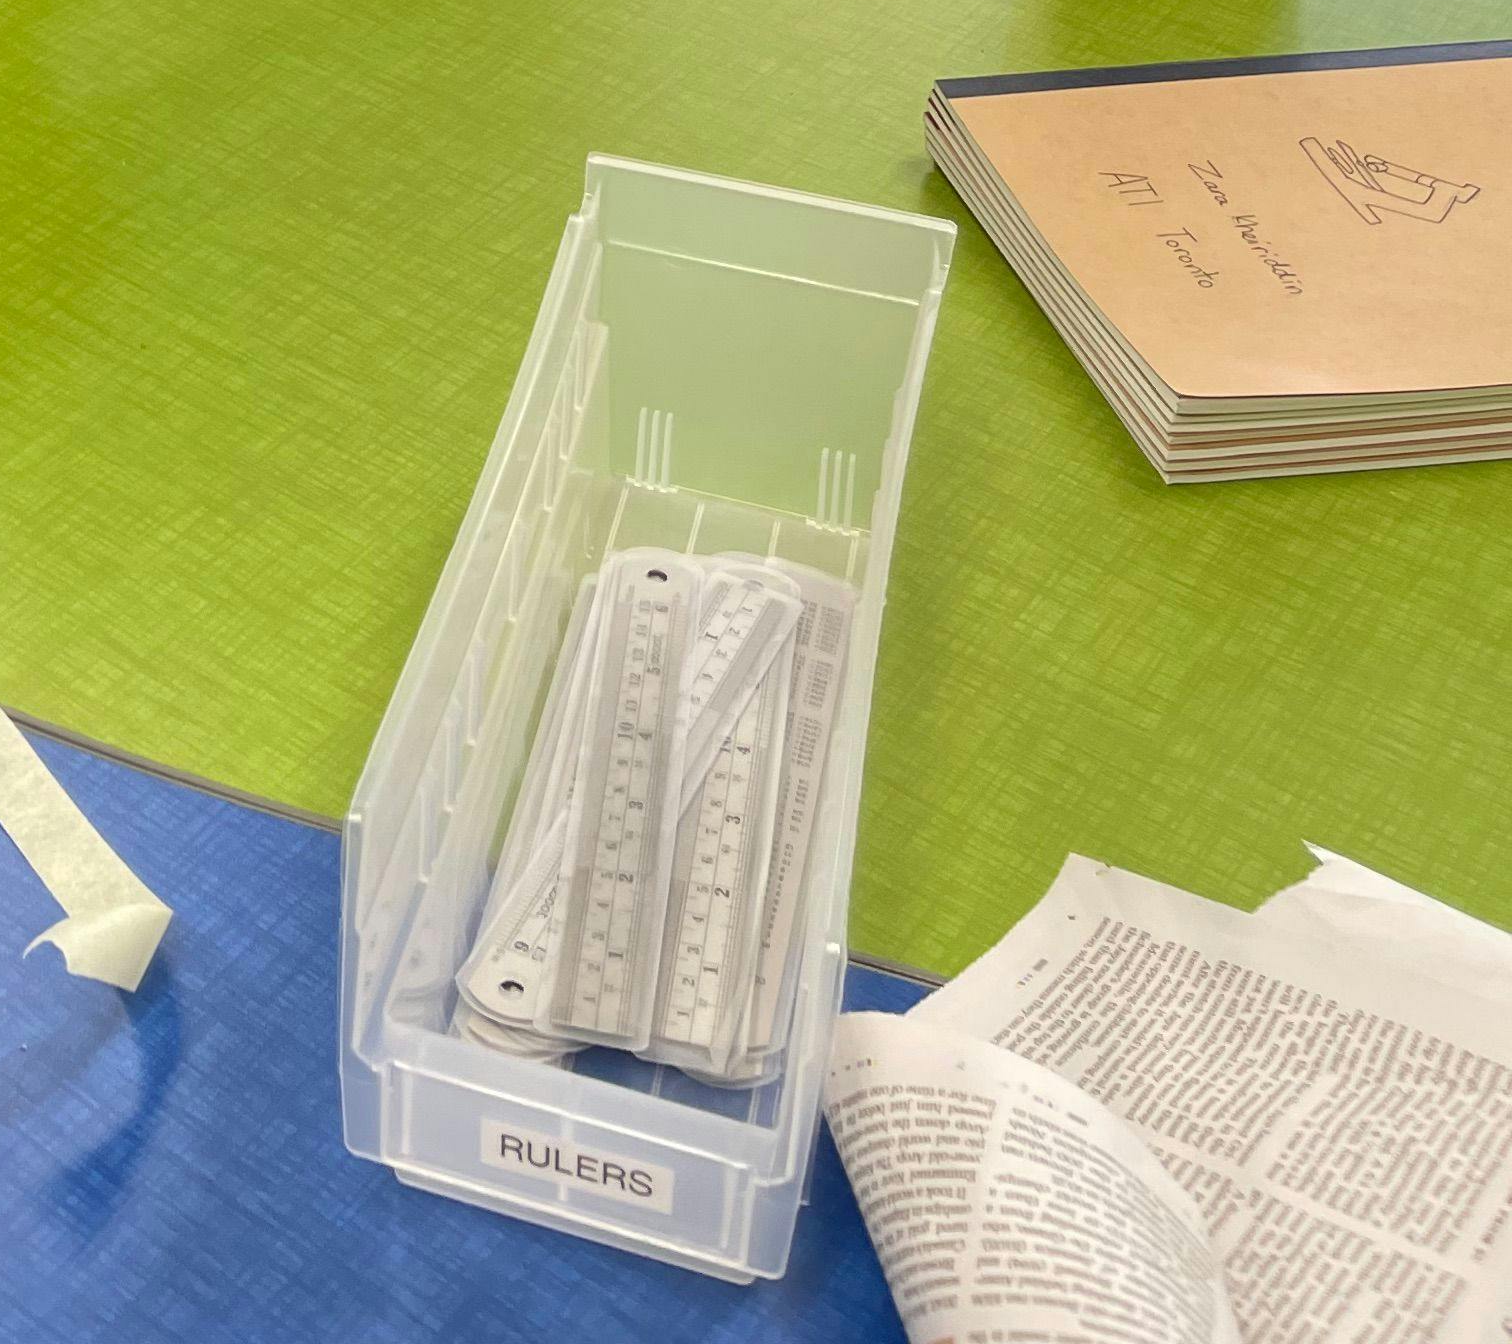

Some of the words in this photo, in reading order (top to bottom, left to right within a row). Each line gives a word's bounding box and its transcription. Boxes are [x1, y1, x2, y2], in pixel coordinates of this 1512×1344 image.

[1188, 159, 1228, 207] Zara
[1156, 227, 1219, 289] Toronto
[705, 632, 718, 640] 1
[608, 950, 624, 960] 1
[618, 872, 634, 883] 2
[628, 800, 643, 810] 3
[638, 731, 653, 741] 4
[703, 965, 719, 975] 1
[714, 887, 730, 898] 2
[725, 814, 742, 825] 3
[736, 745, 752, 755] 4
[687, 945, 701, 955] 3
[682, 977, 696, 987] 2
[499, 1132, 654, 1198] RULERS
